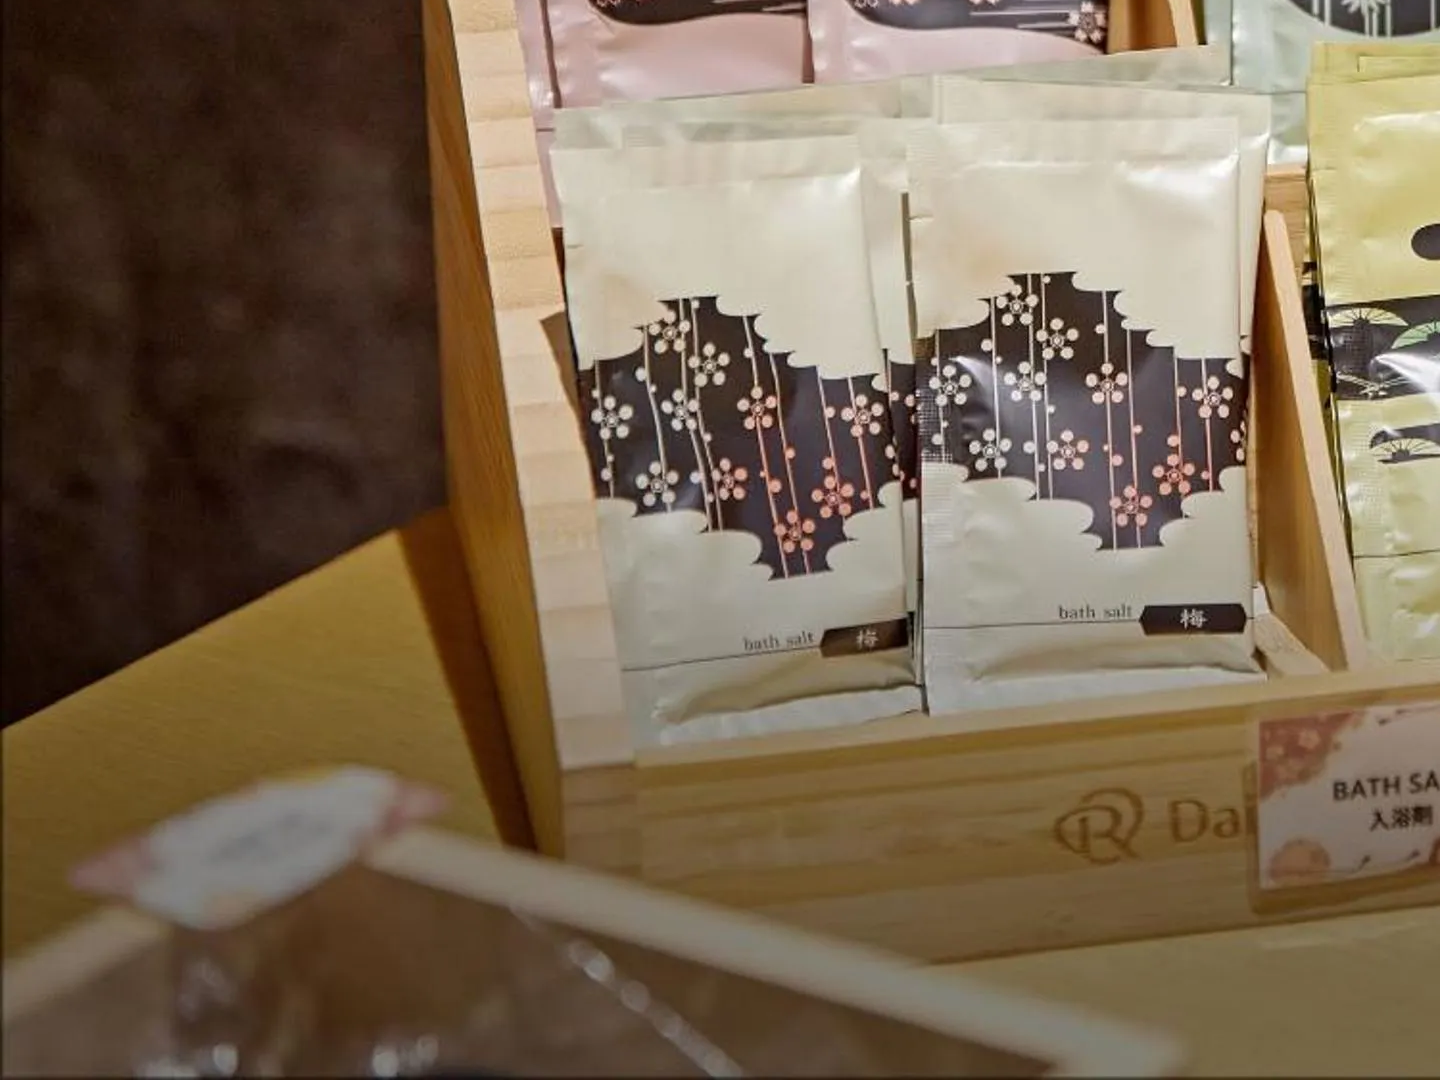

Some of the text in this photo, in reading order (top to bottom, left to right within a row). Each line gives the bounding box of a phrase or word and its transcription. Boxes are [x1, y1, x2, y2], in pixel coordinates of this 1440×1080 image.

[1058, 604, 1133, 620] bath salt
[1179, 607, 1208, 628] 梅
[743, 631, 815, 653] bath salt
[1332, 775, 1401, 802] BATH
